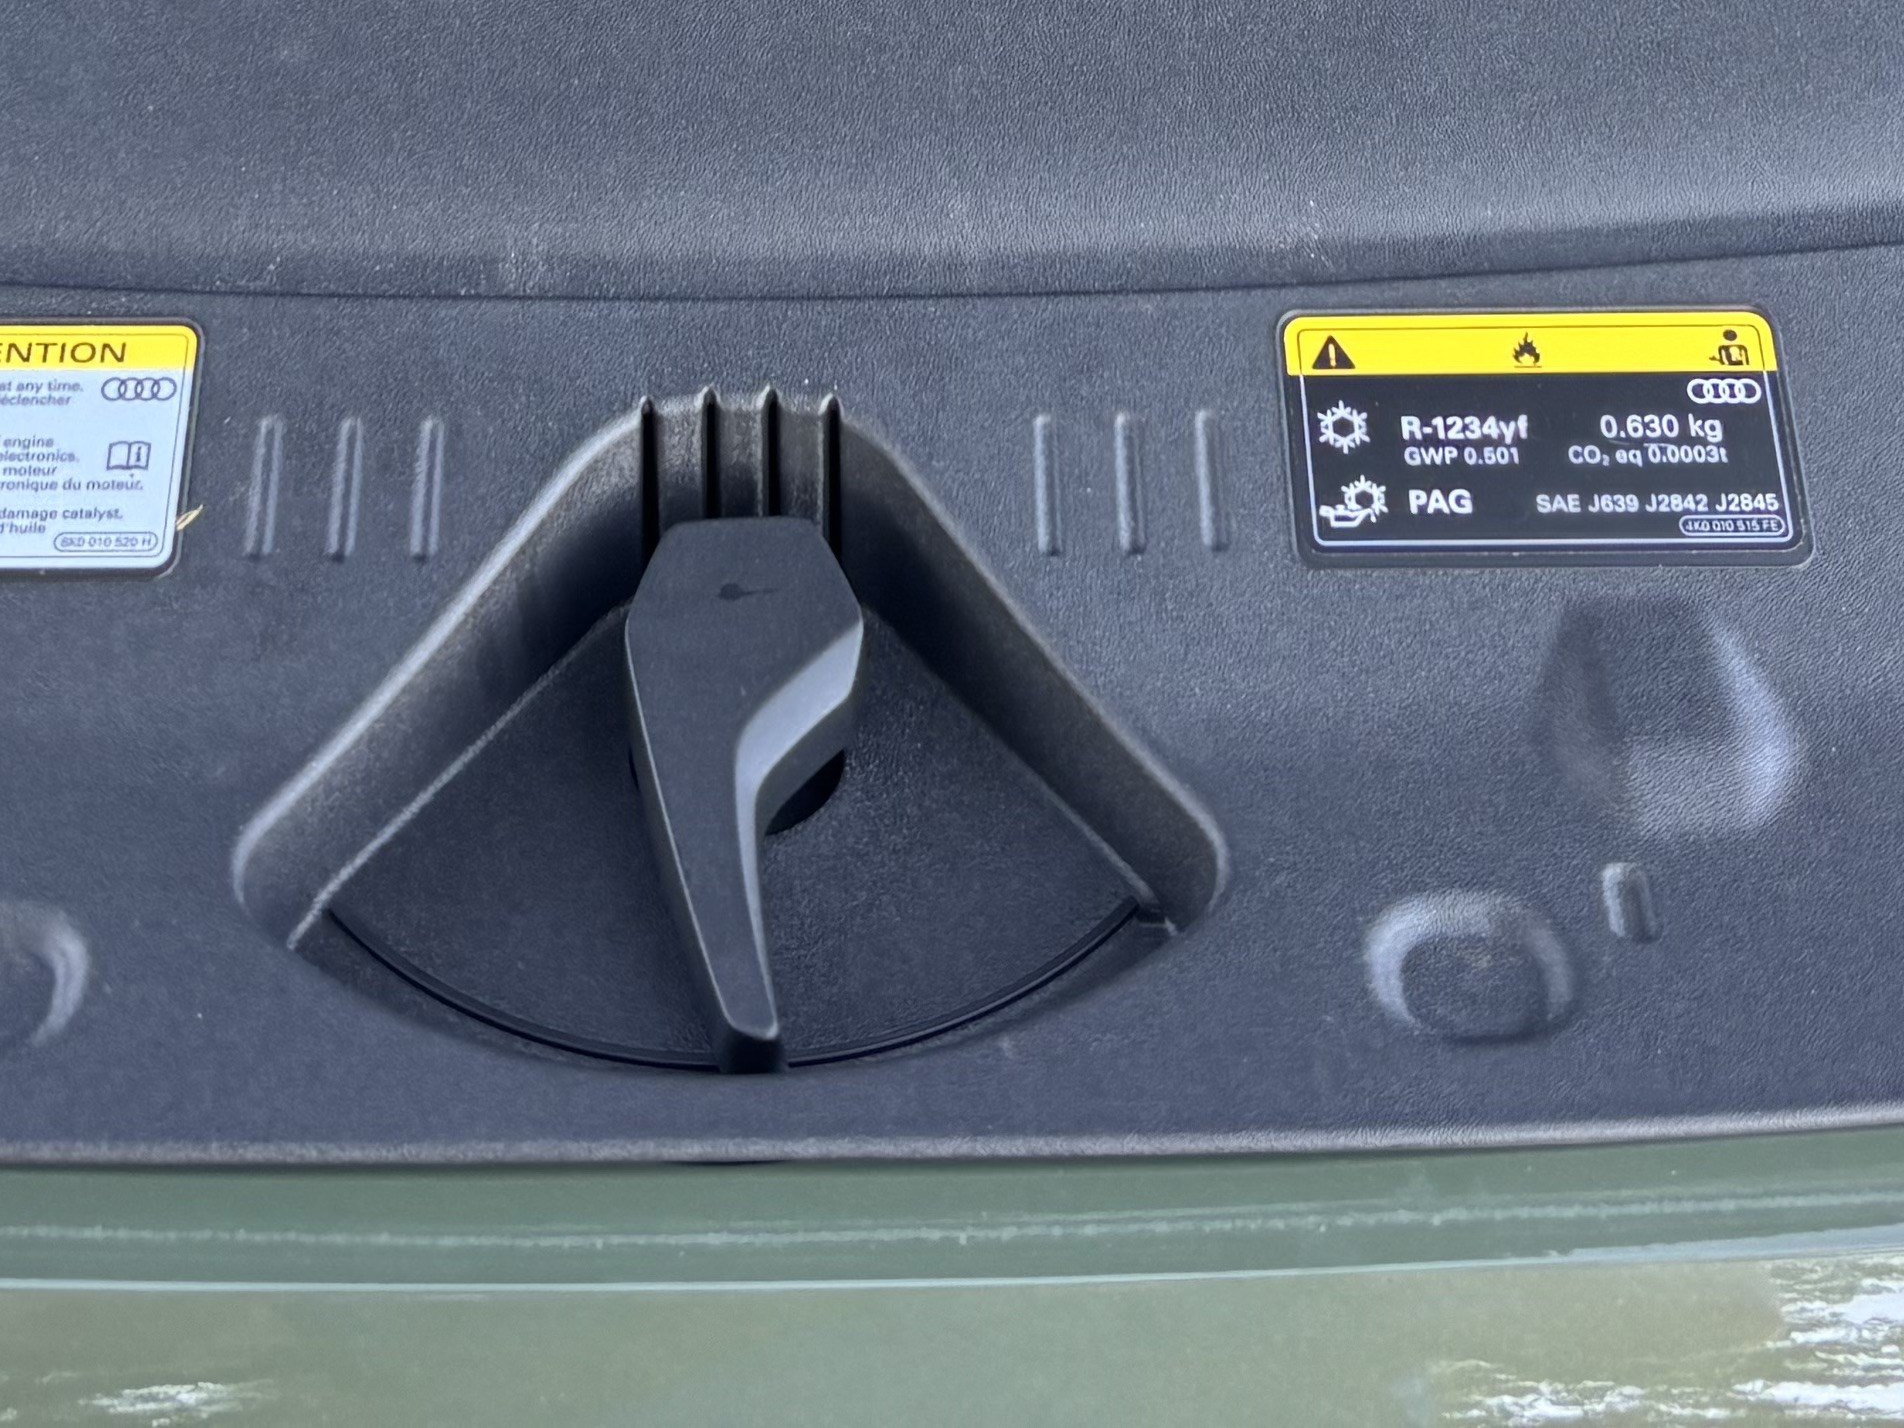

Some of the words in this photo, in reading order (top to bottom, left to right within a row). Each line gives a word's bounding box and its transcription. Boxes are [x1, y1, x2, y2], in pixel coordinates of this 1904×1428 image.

[16, 382, 43, 395] any
[47, 379, 84, 394] time.
[1400, 414, 1528, 444] R-1234yf
[1599, 414, 1680, 439] 0.630
[1688, 413, 1724, 443] kg
[4, 437, 55, 452] engine
[1403, 446, 1459, 466] GWP
[1463, 446, 1521, 465] 0.501
[1615, 447, 1643, 469] eq
[1647, 444, 1728, 464] 0.0003t
[2, 464, 58, 478] moteur
[61, 478, 82, 492] du
[85, 478, 143, 492] moteur.
[1408, 490, 1474, 515] PAG
[1535, 494, 1581, 513] SAE
[1587, 493, 1640, 513] J639
[1645, 492, 1710, 512] J2842
[1715, 492, 1780, 512] J2845
[61, 507, 124, 523] catalyst.
